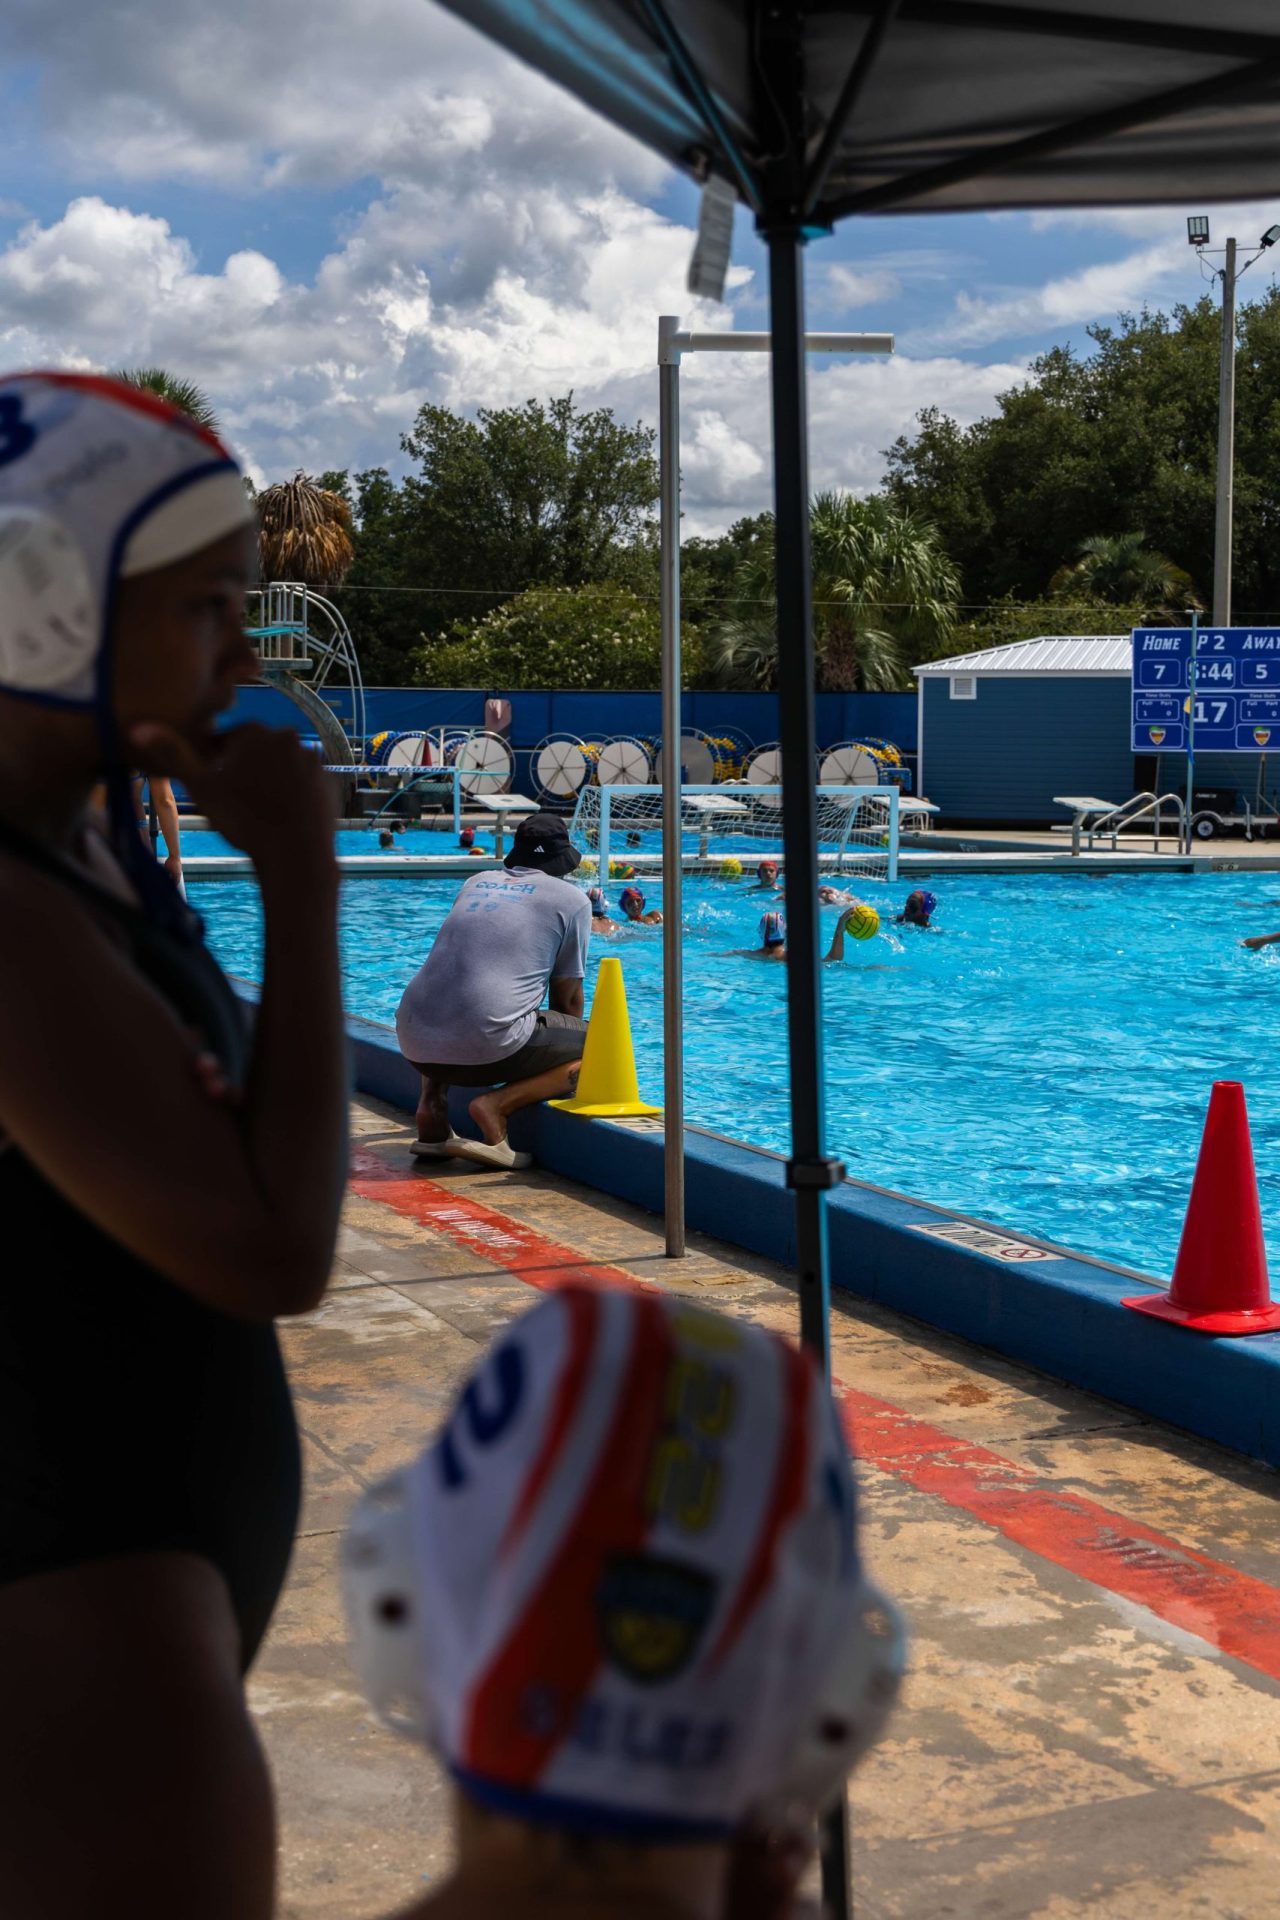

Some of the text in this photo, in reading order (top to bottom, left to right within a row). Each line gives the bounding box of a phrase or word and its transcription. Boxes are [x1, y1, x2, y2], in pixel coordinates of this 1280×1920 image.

[1196, 635, 1225, 650] P 2
[1154, 665, 1166, 680] 7
[1255, 664, 1268, 679] 5
[1193, 702, 1228, 723] 17
[475, 880, 538, 895] COACH
